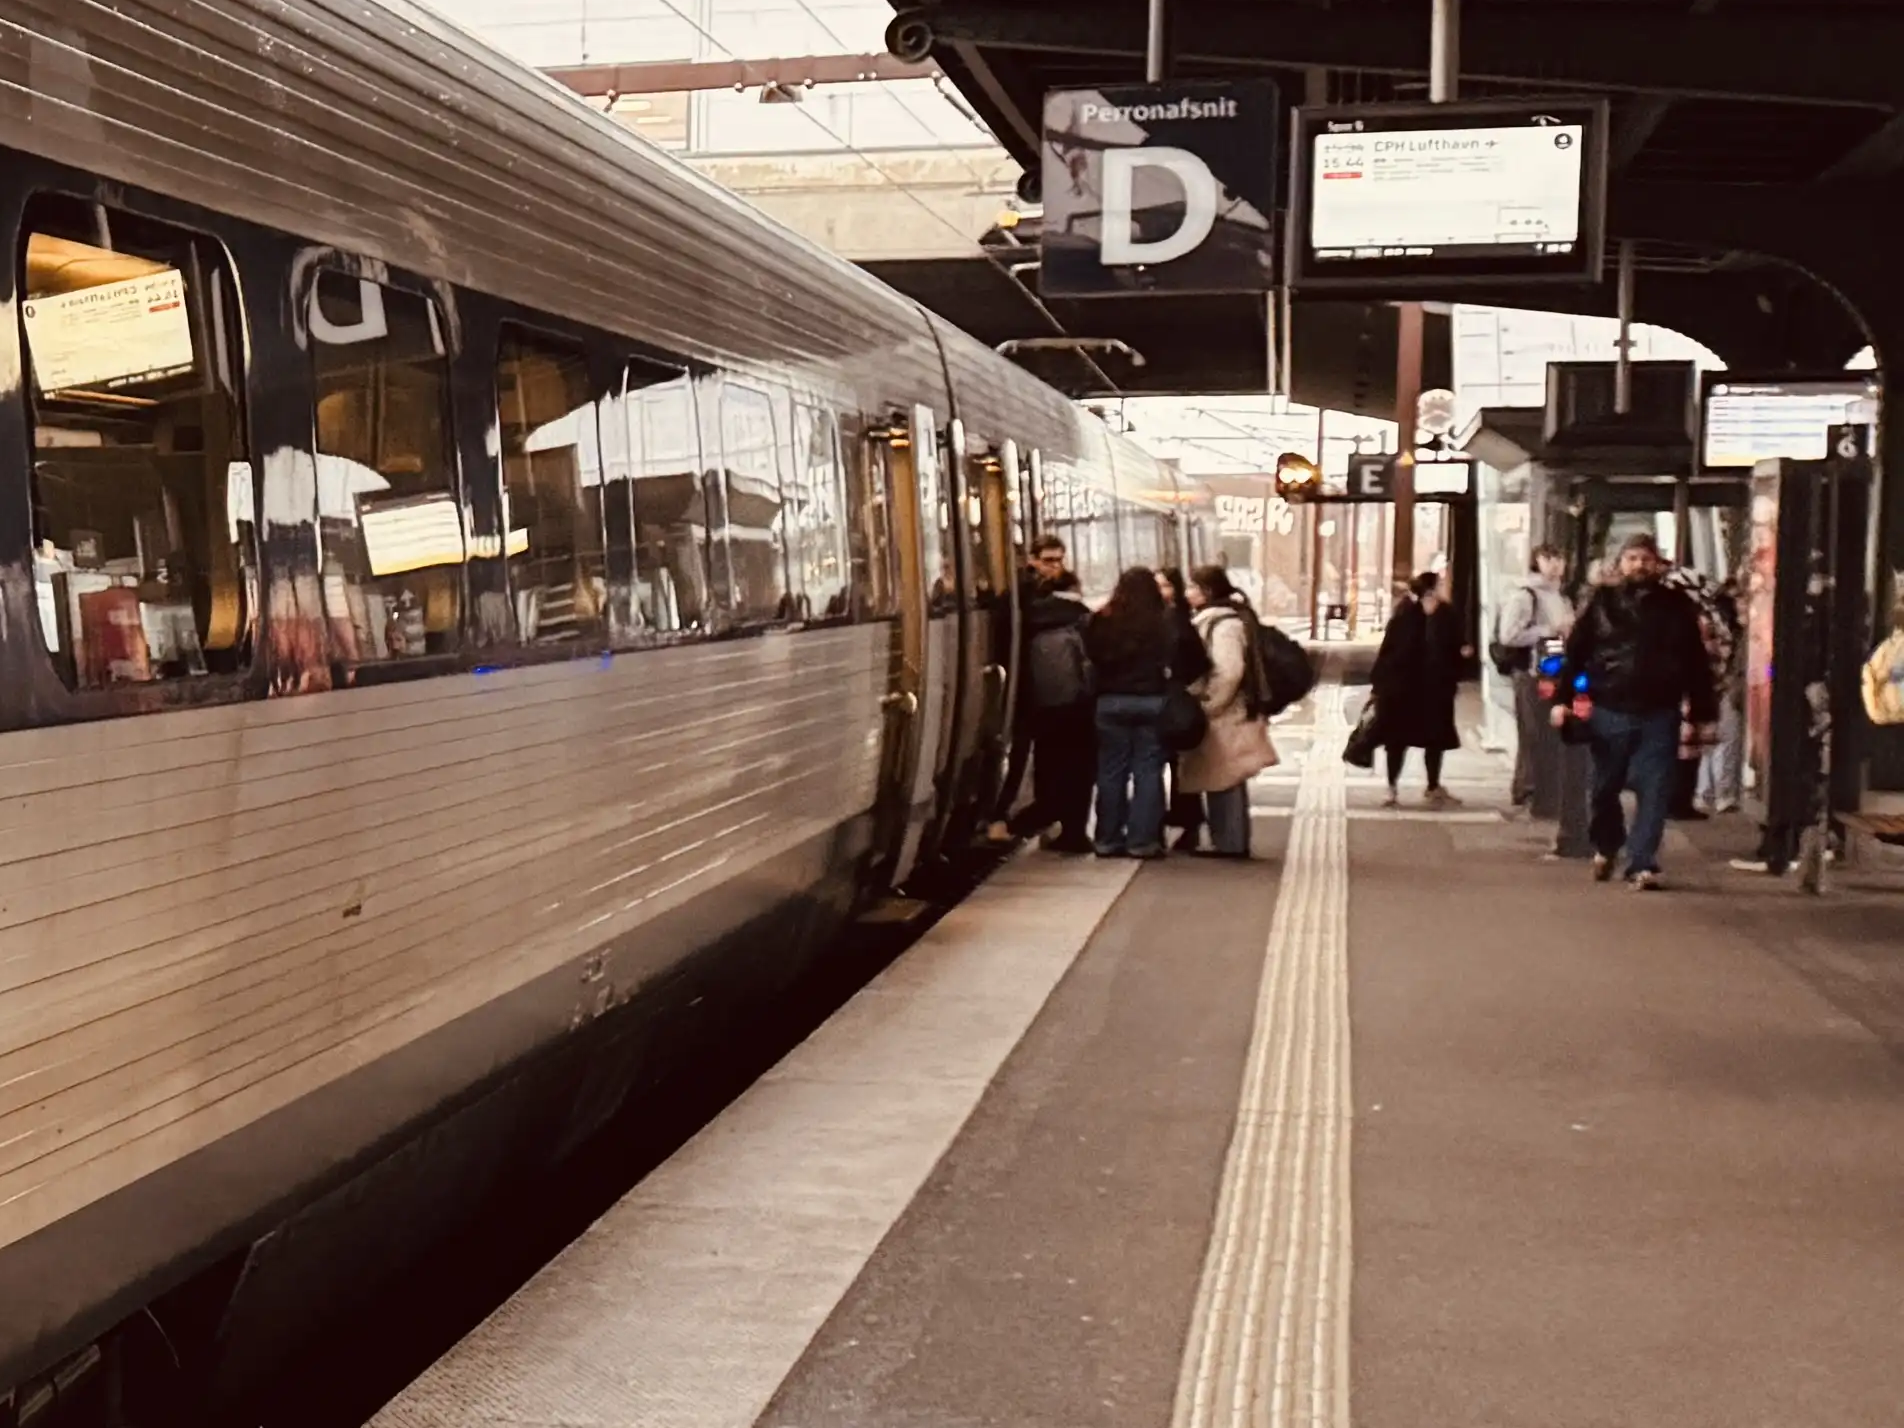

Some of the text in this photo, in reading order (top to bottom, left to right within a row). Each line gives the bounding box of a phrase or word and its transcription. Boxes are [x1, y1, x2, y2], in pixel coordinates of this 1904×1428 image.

[1081, 95, 1238, 125] Perronafsnit
[1374, 140, 1405, 153] CPH
[1098, 144, 1217, 267] D
[1360, 464, 1386, 495] E
